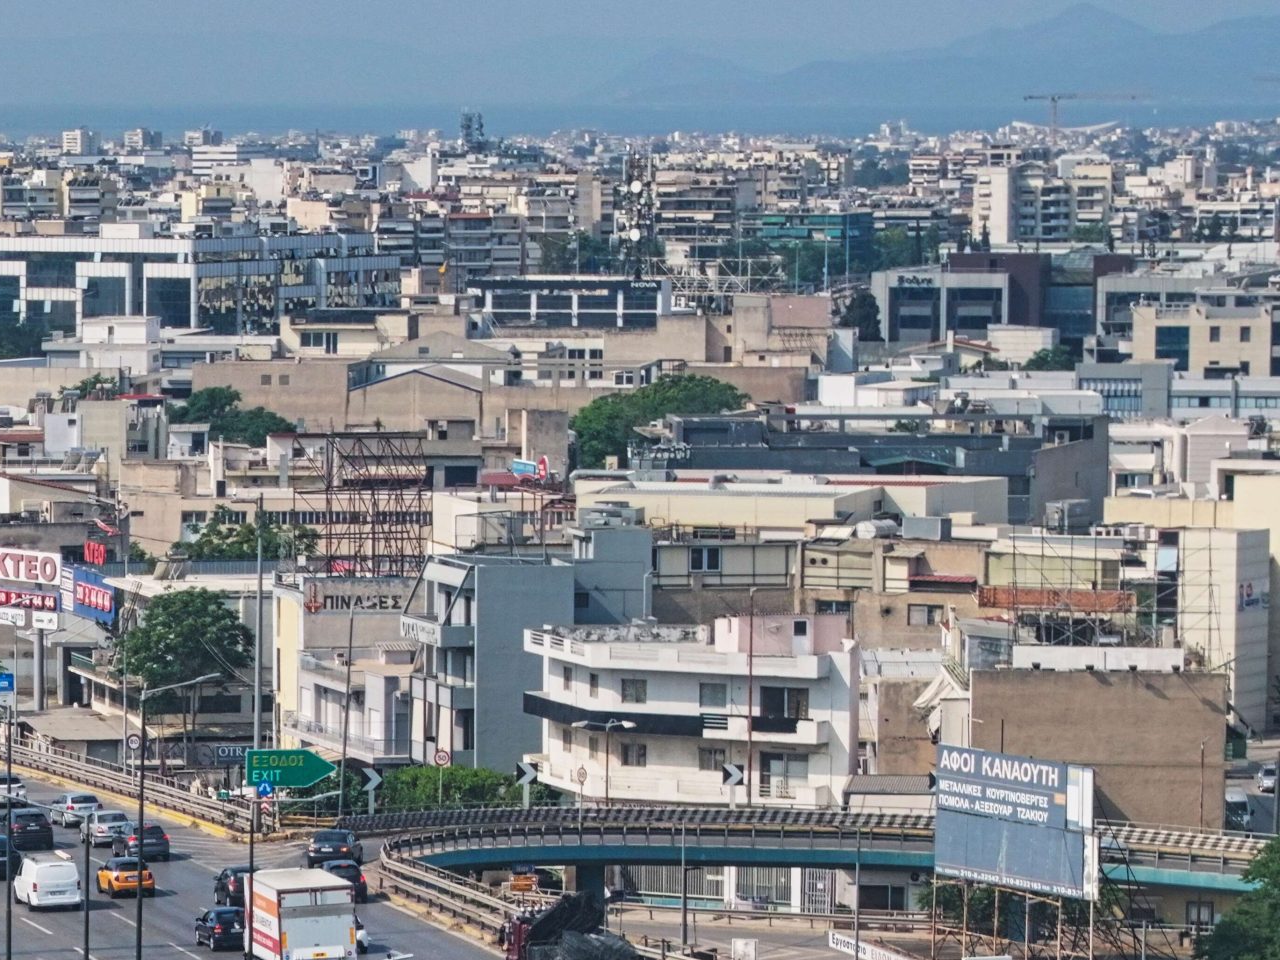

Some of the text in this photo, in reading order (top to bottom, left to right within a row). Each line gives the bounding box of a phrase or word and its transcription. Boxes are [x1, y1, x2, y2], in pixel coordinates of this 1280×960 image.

[83, 540, 106, 566] ΚΤΕΟ
[44, 596, 55, 608] 44
[252, 755, 304, 767] ΕΞΟΔΟΣ
[940, 750, 1059, 787] ΑΦΟΙ ΚΑΝΑΟΥΤΗ
[252, 770, 281, 781] EXIT
[939, 780, 1049, 808] ΜΕΤΑΛΛΙΚΕΣ ΚΟΥΡΤΙΝΟΒΕΡΓΕΣ
[938, 794, 970, 809] ΠΟΜΟΛΑ
[975, 801, 1013, 818] ΑΞΕΣΟΥΑΡ
[1017, 807, 1049, 823] ΤΖΑΚΙΟΥ
